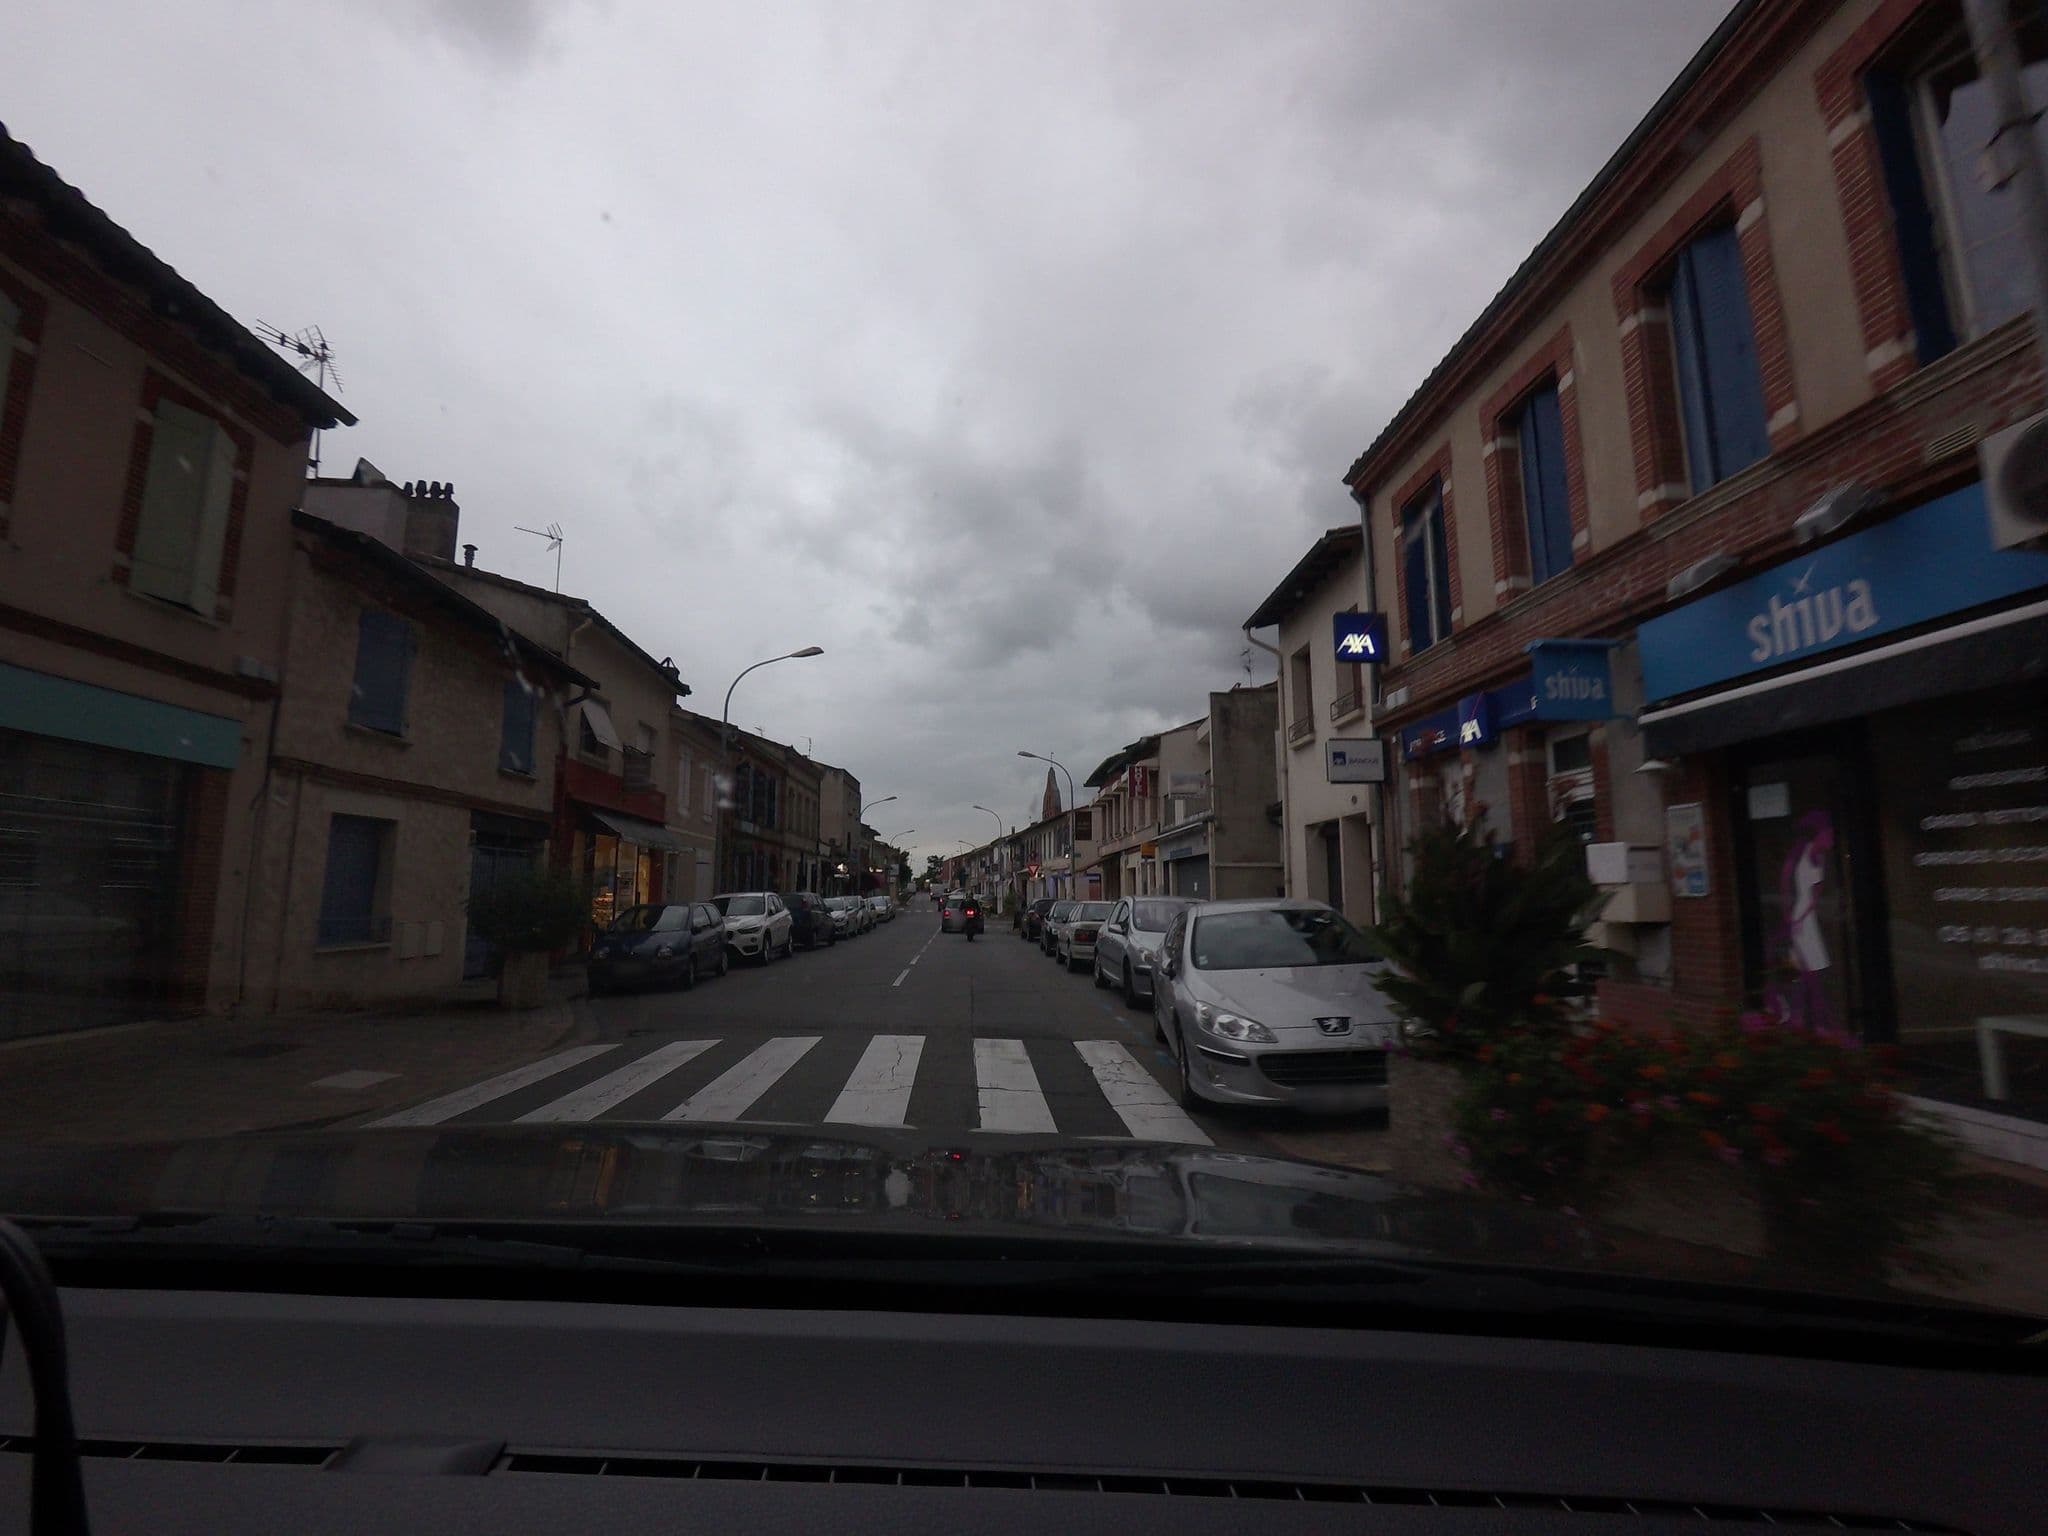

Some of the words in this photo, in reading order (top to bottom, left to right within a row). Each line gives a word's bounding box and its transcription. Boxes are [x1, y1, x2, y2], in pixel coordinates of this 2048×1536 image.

[1748, 568, 1881, 663] shiva
[1336, 633, 1376, 655] AXA
[1545, 665, 1607, 701] shiva
